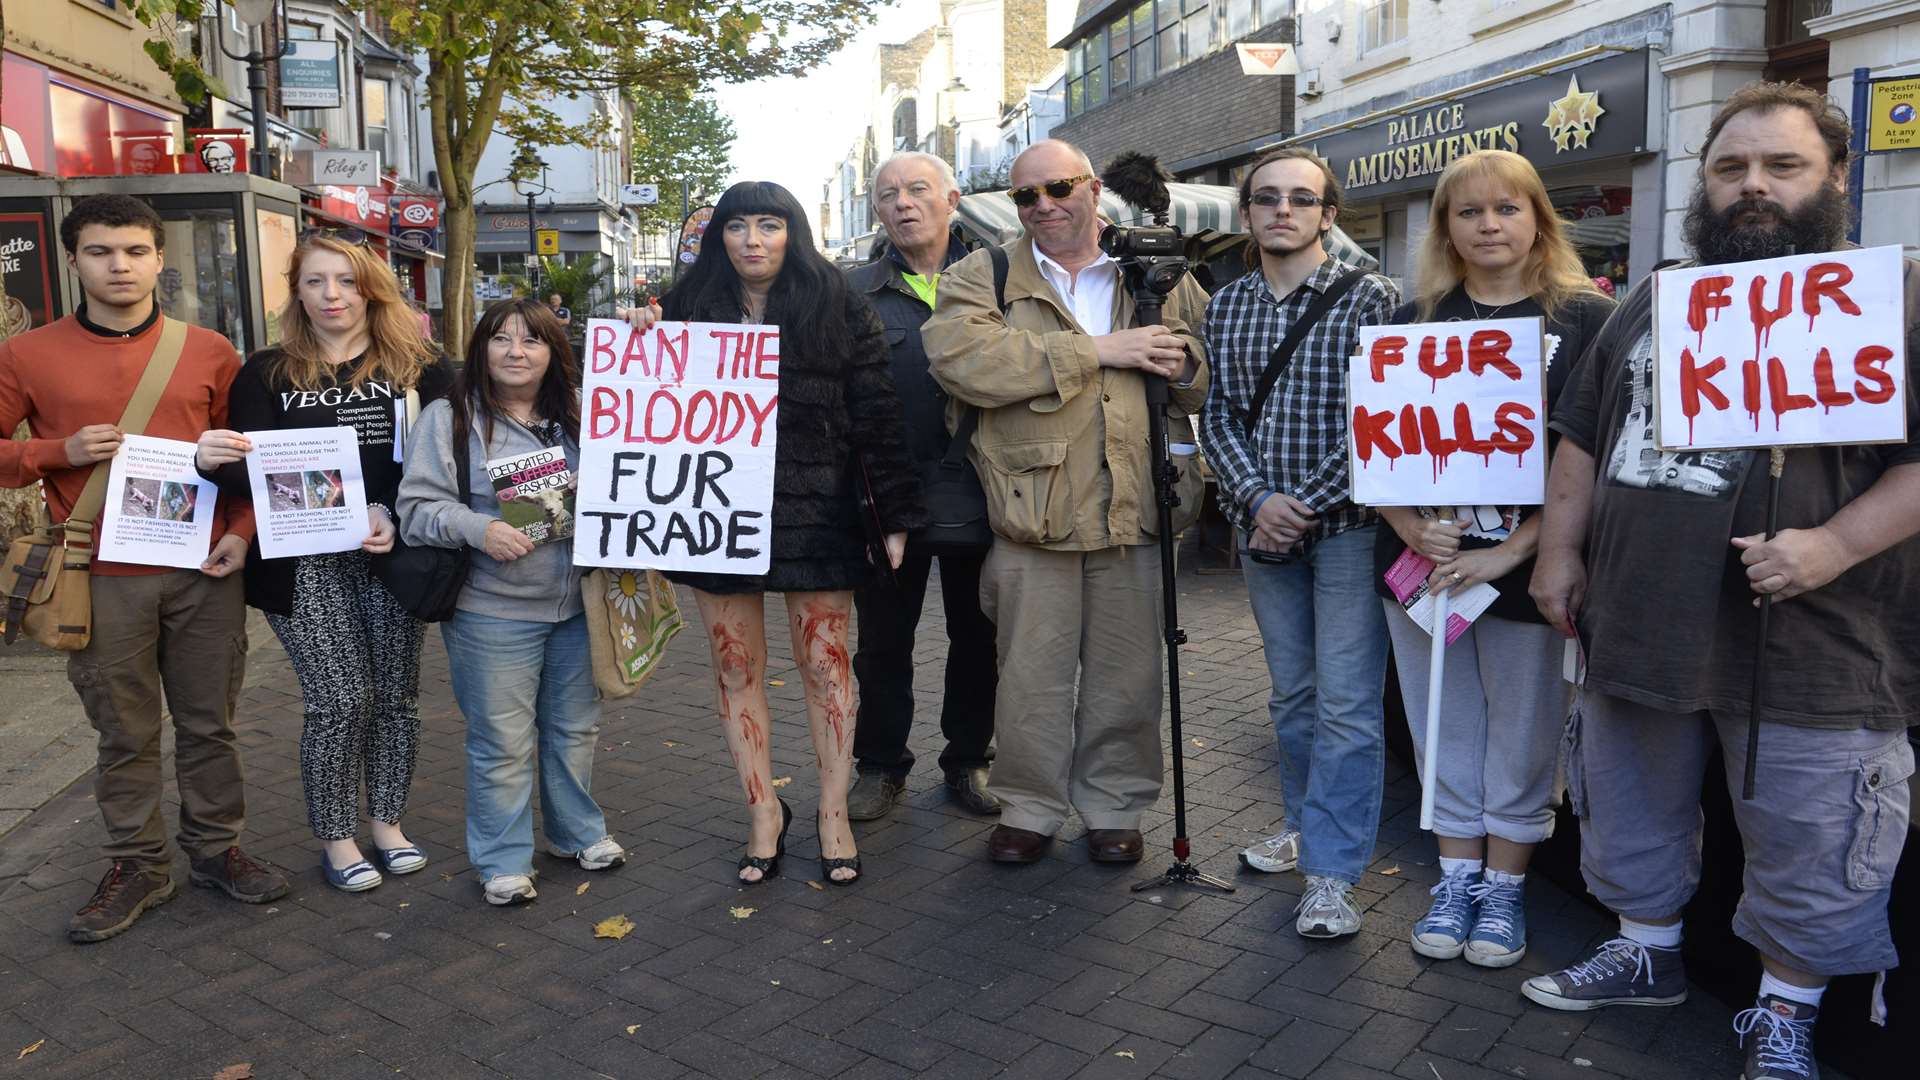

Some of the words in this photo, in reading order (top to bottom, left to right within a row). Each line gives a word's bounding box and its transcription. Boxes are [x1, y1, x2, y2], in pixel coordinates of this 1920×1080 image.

[1387, 103, 1465, 146] PALACE
[1898, 128, 1916, 136] any
[323, 158, 368, 178] Riley's
[1344, 121, 1519, 190] AMUSEMENTS
[1687, 262, 1862, 338] FUR
[591, 326, 689, 381] BAN
[710, 330, 780, 380] THE
[1370, 330, 1522, 386] FUR
[280, 381, 392, 412] VEGAN
[1680, 345, 1896, 424] KILLS
[336, 405, 386, 415] Compassion.
[337, 413, 388, 422] Nonviolence.
[366, 421, 392, 429] People.
[589, 386, 779, 448] BLOODY
[1352, 402, 1536, 468] KILLS
[141, 456, 165, 464] SHOULD
[511, 459, 567, 486] SUFFERER
[608, 450, 734, 508] FUR
[517, 472, 569, 495] FASHION
[581, 509, 764, 560] TRADE
